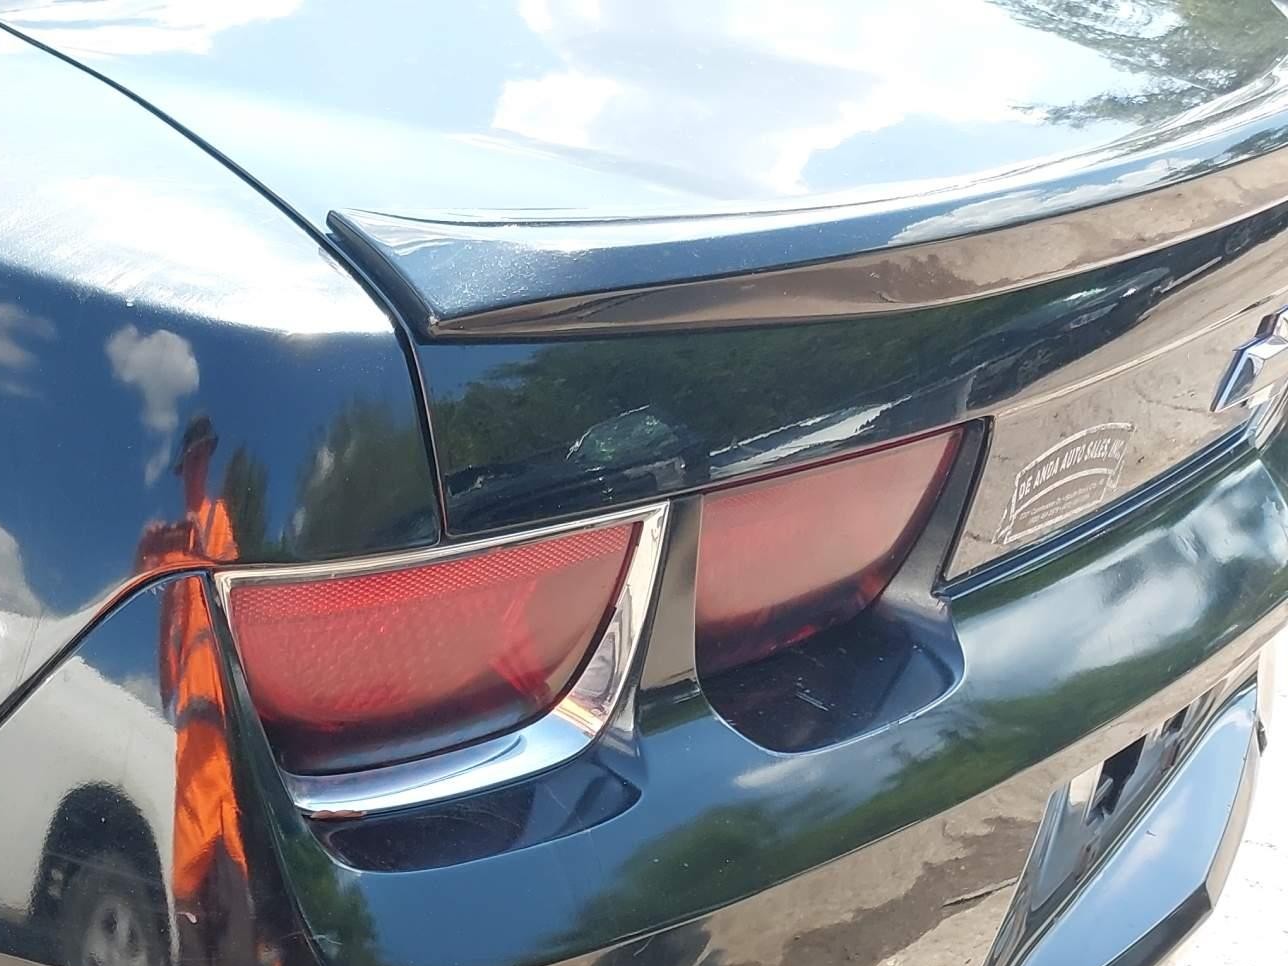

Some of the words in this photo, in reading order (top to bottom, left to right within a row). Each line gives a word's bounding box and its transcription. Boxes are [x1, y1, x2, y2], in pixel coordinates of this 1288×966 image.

[1018, 475, 1033, 501] DE
[1033, 457, 1060, 489] ANDA
[1060, 444, 1086, 472] AUTO
